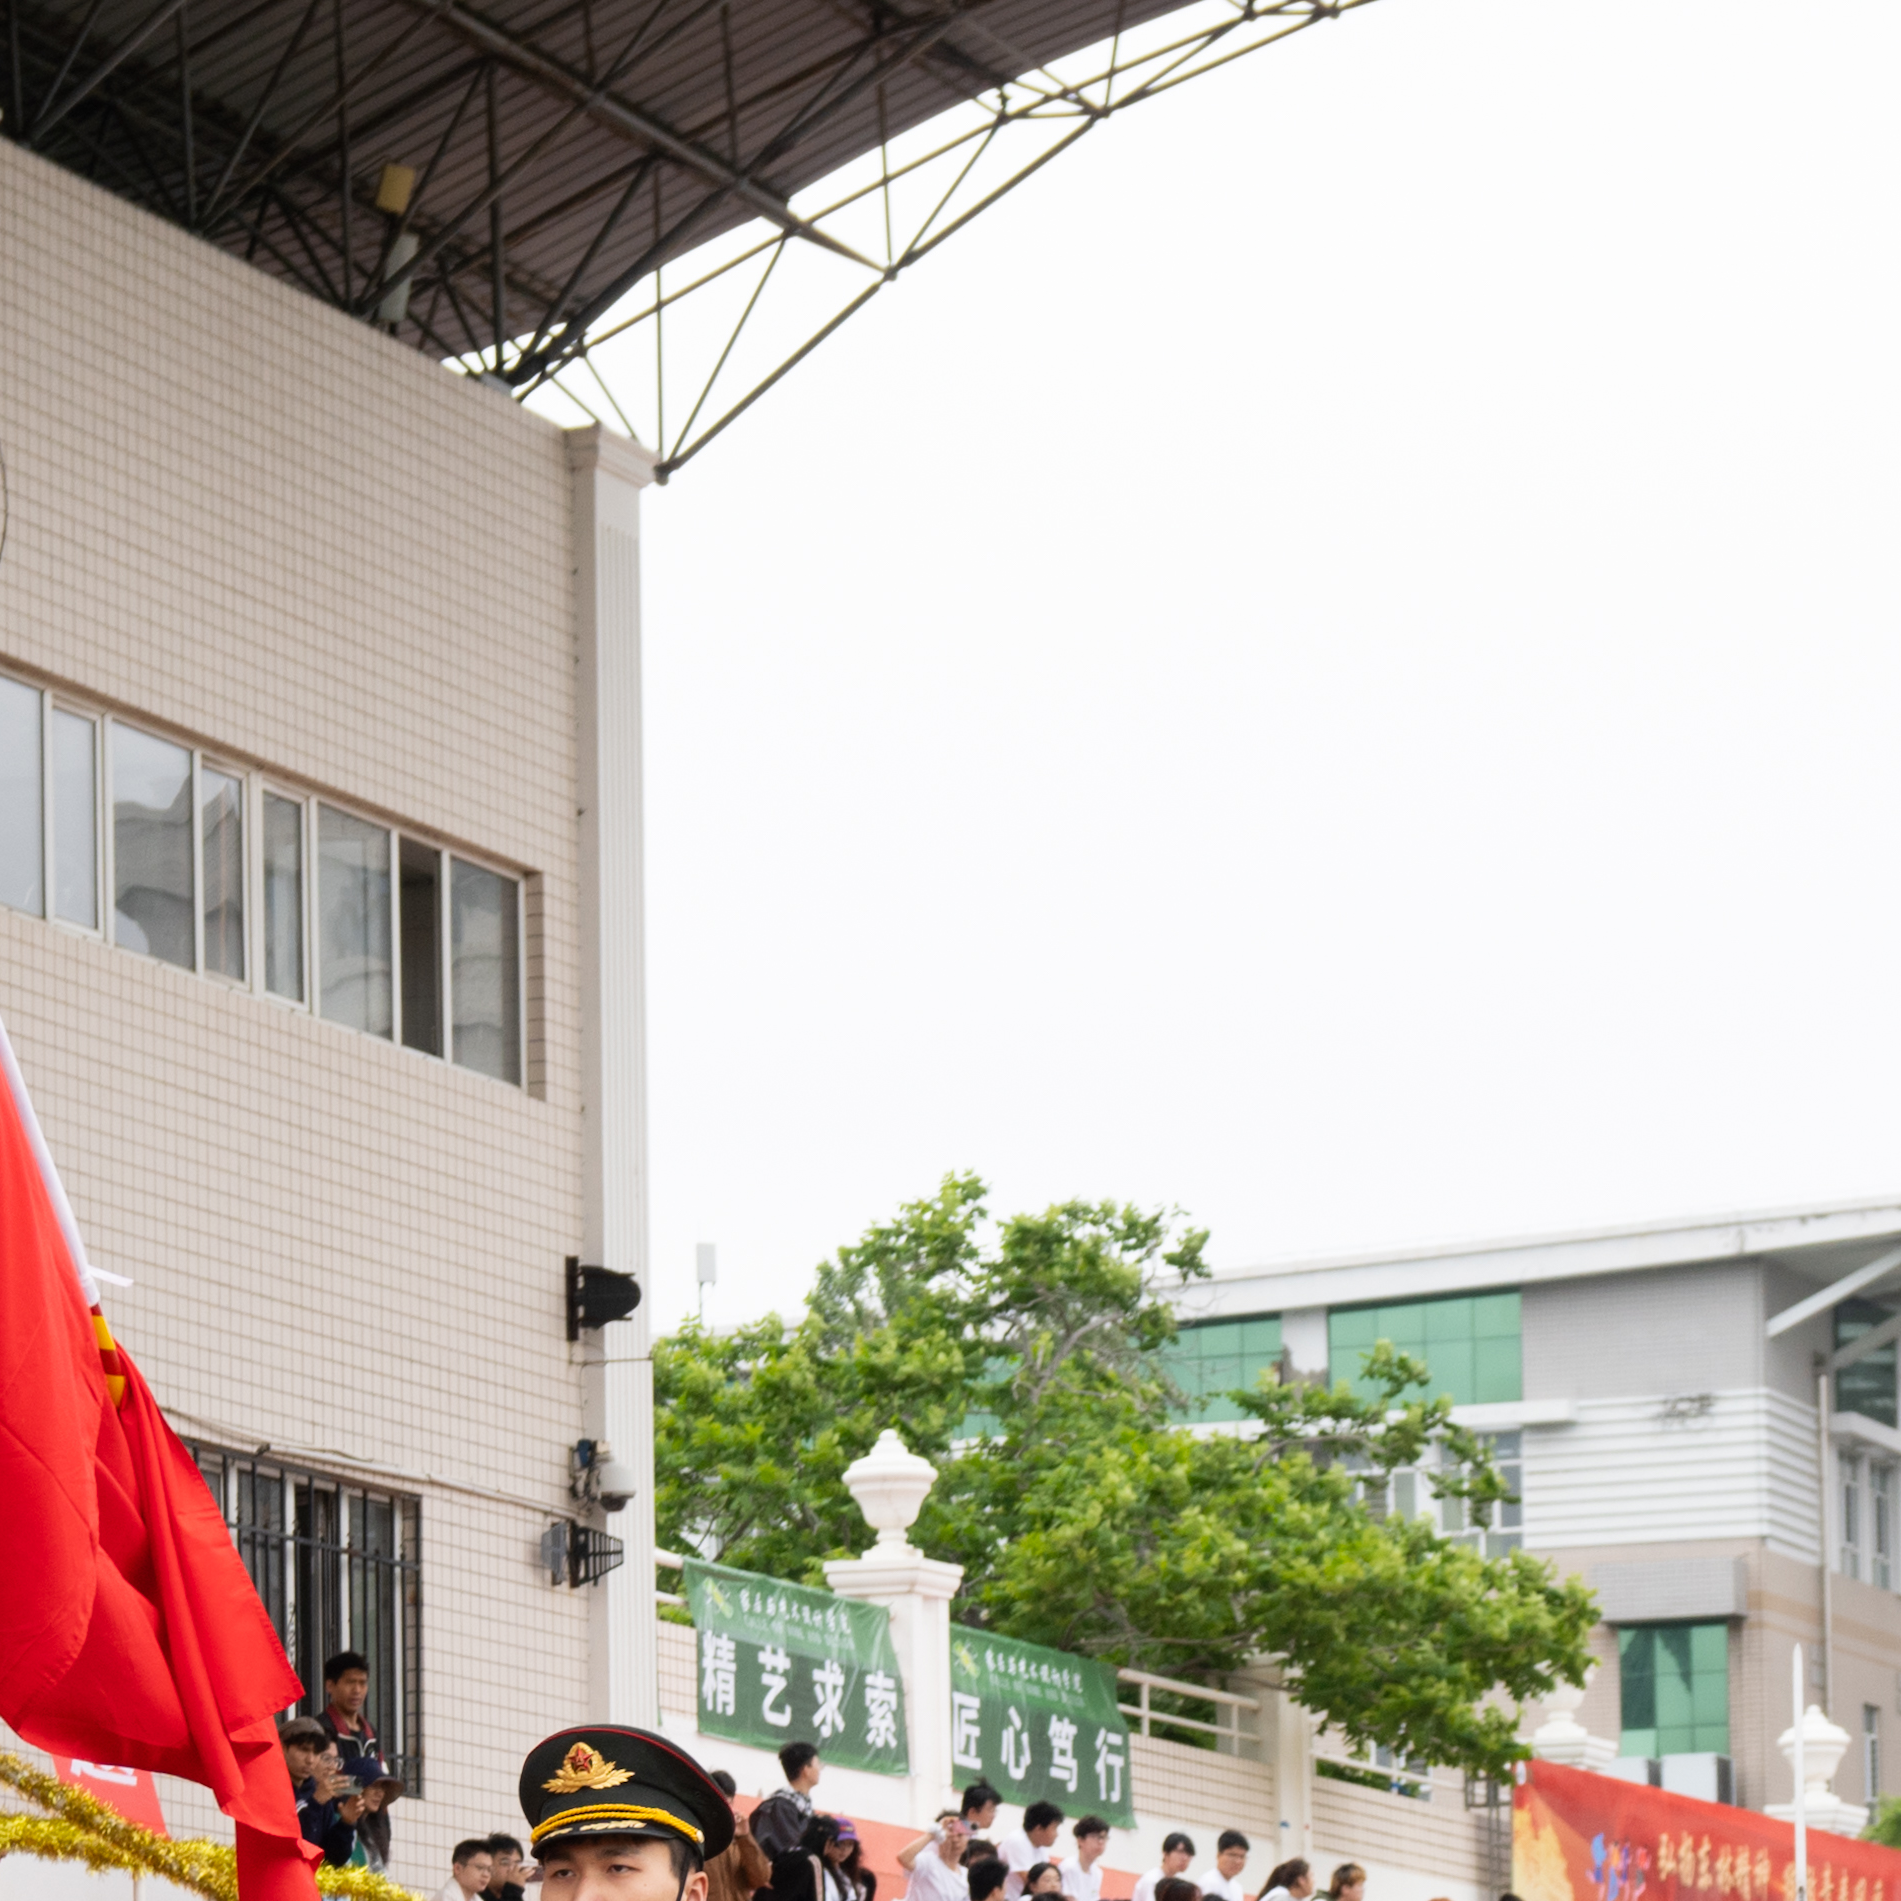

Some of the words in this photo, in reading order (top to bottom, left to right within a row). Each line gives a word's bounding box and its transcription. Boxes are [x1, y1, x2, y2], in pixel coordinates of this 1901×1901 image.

[701, 1629, 898, 1749] 精艺求索
[952, 1690, 1125, 1804] 匠心笃行
